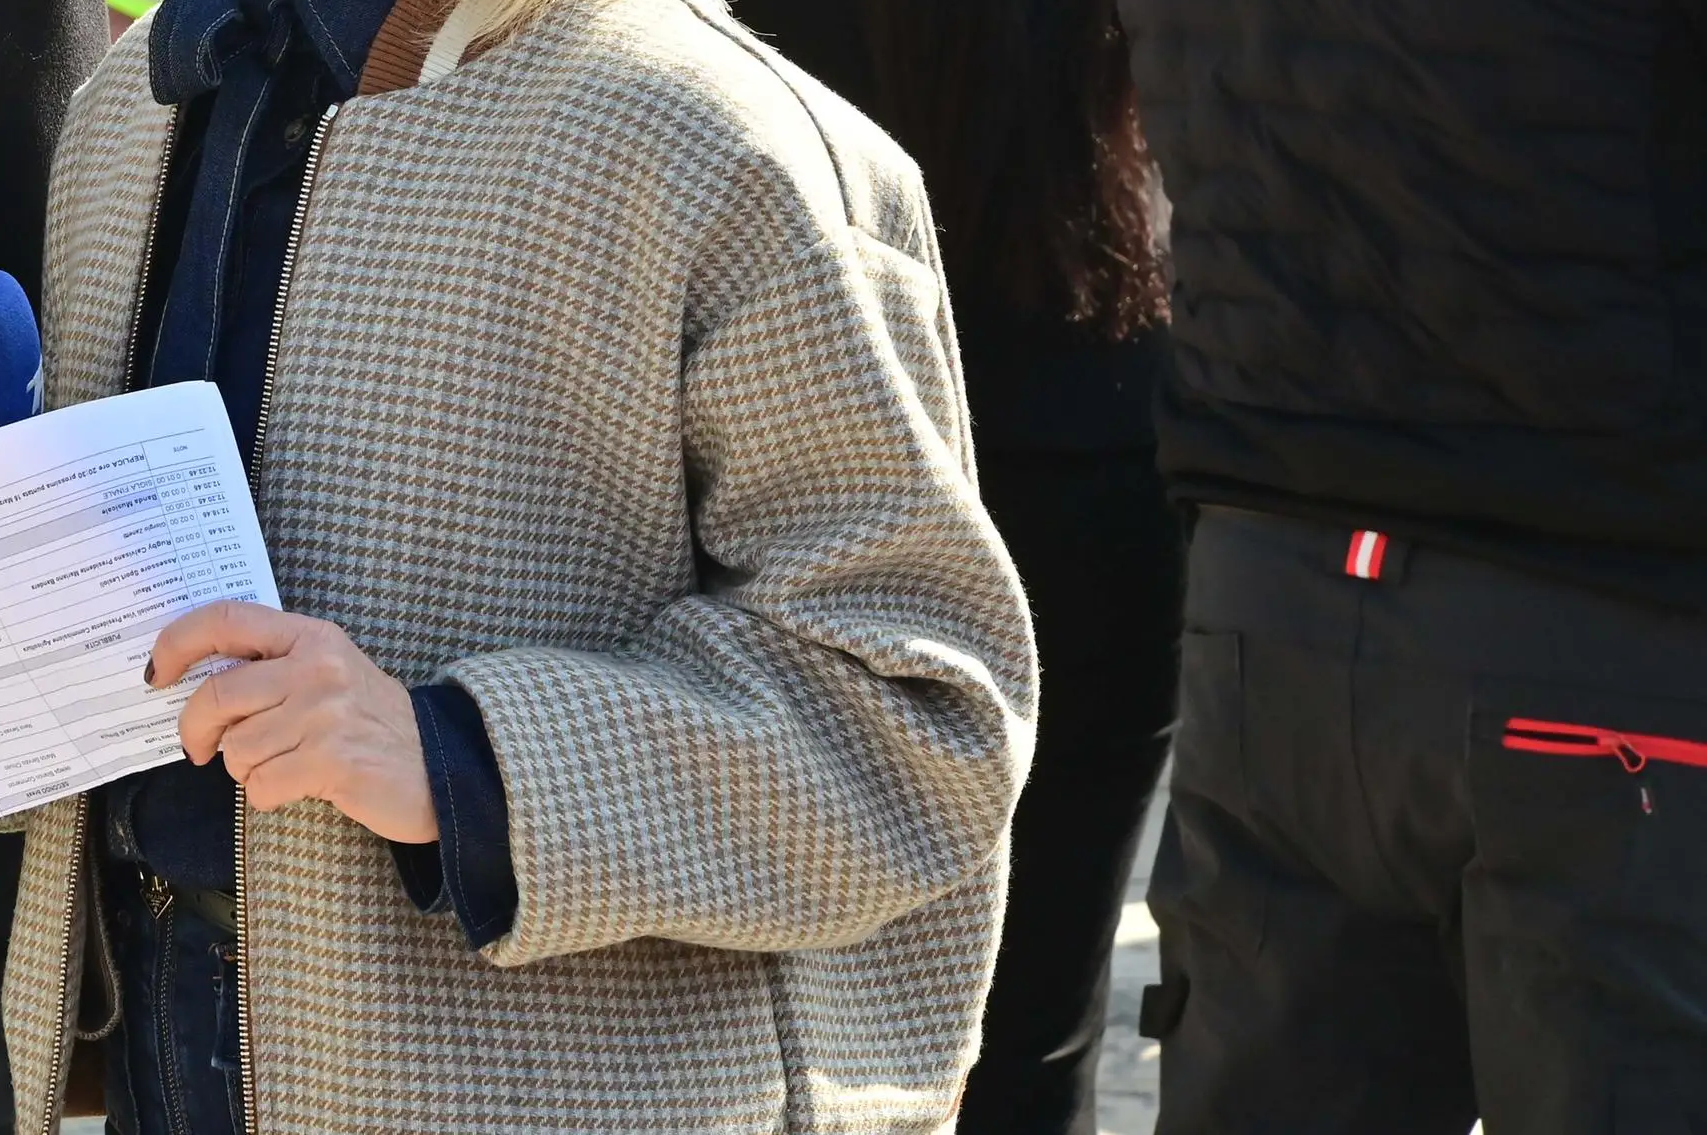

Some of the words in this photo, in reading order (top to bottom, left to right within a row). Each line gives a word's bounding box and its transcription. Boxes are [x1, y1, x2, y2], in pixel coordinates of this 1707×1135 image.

[172, 444, 188, 452] NOTE
[98, 463, 110, 471] ore
[112, 453, 144, 468] REPLICA
[45, 473, 76, 490] prossima
[130, 479, 152, 491] SIGLA
[22, 484, 45, 497] puntata
[102, 485, 129, 499] FINALE
[134, 493, 157, 505] Banda
[101, 500, 133, 515] Musicale
[143, 521, 166, 532] Giorgio
[147, 538, 172, 550] Rugby
[113, 546, 147, 562] Calvisano
[80, 558, 113, 574] Presidente
[140, 557, 177, 573] Assessore
[56, 570, 79, 583] Mariano
[120, 568, 139, 580] Sport
[152, 575, 182, 589] Federica
[166, 594, 188, 605] Marco
[122, 611, 136, 620] Vice
[90, 616, 122, 631] Presidente
[52, 627, 90, 644] Commissione
